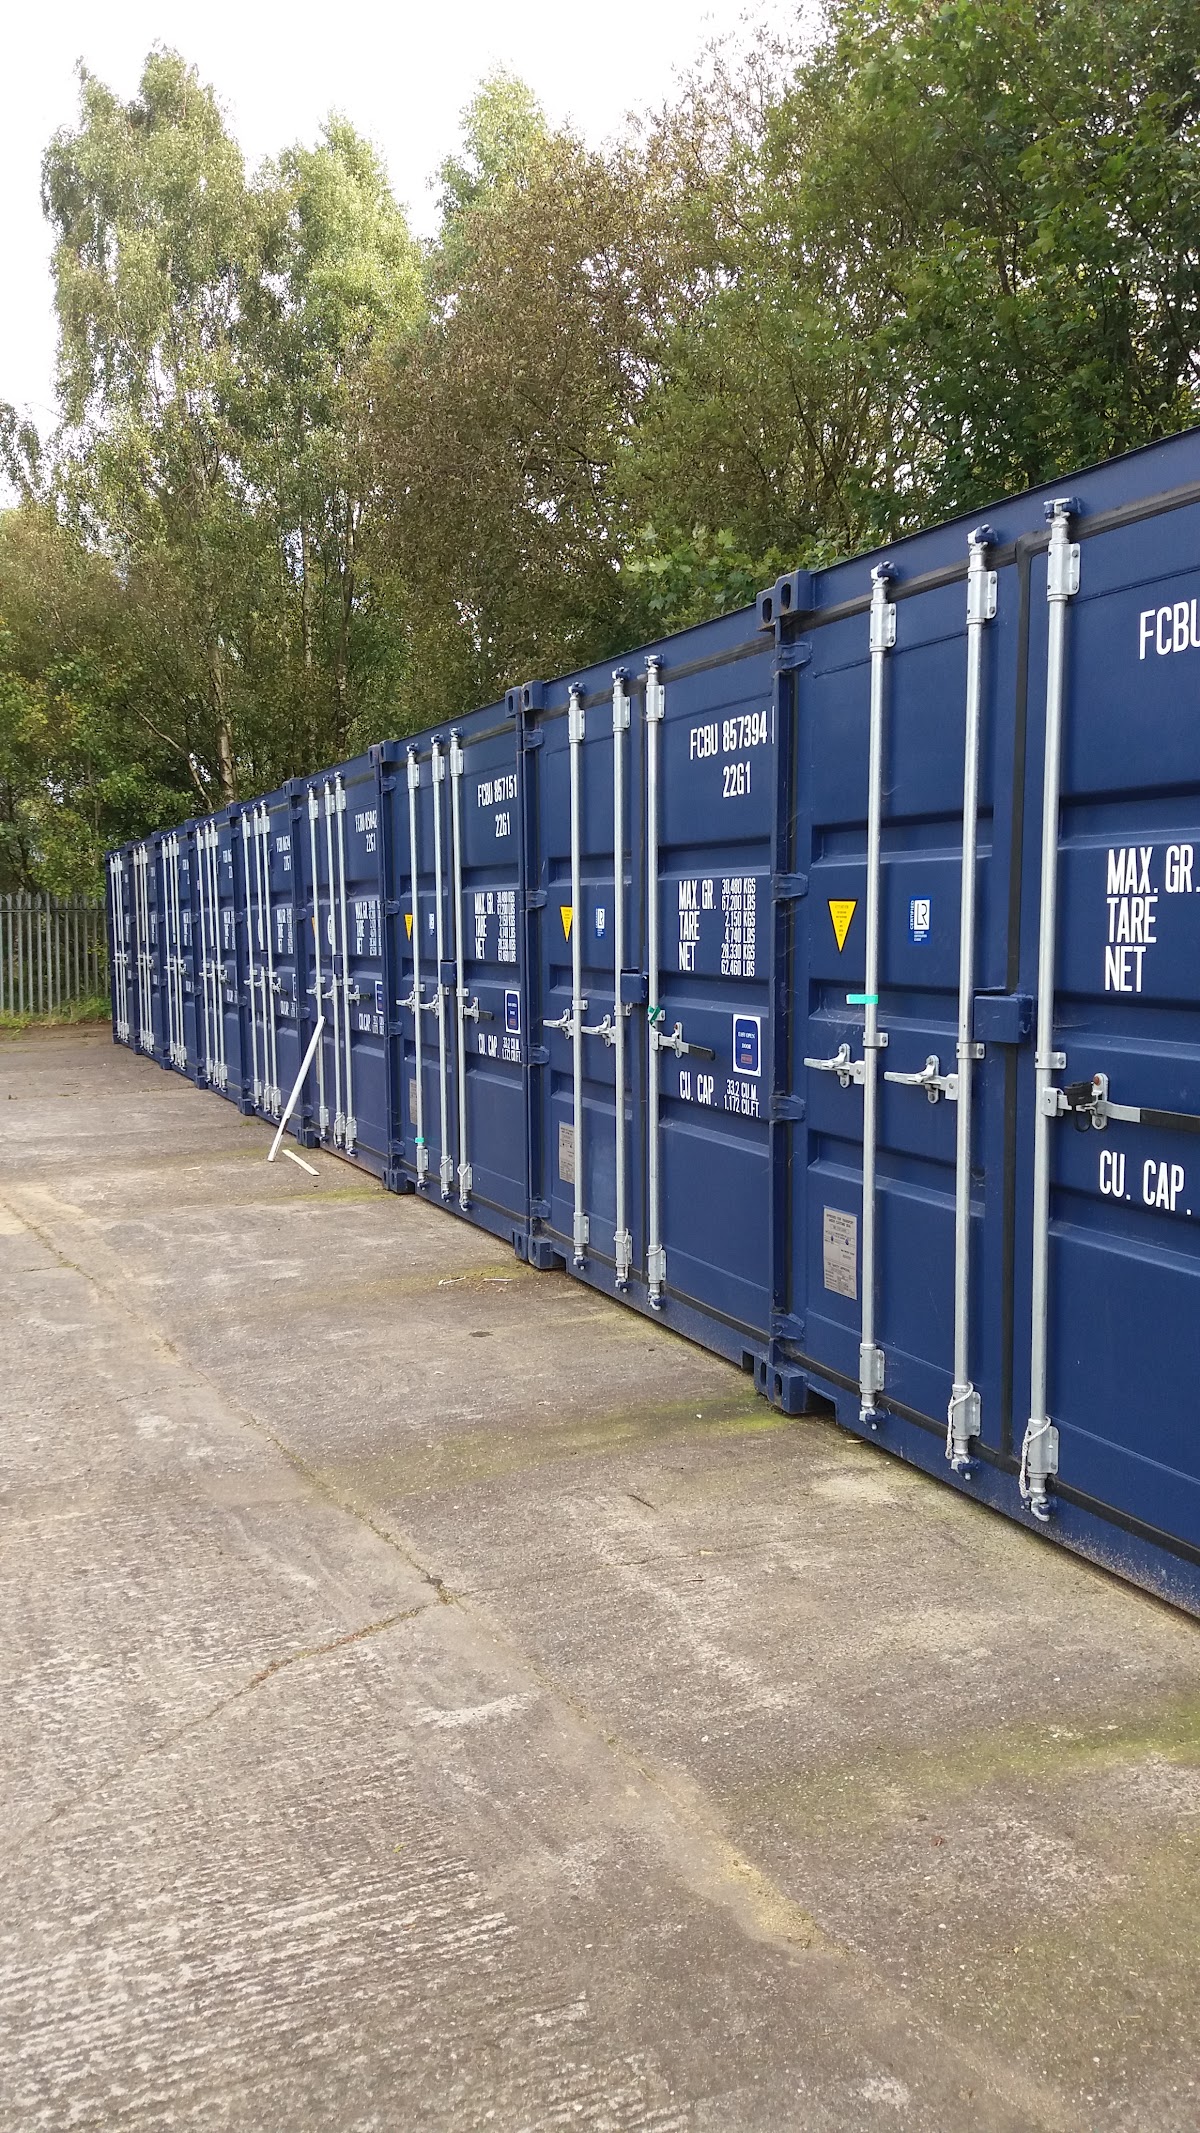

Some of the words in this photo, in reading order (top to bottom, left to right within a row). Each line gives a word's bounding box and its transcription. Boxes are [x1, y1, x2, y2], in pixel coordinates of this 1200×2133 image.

[690, 722, 719, 760] FCBU
[722, 710, 767, 752] 857394
[477, 782, 494, 808] FCBU
[494, 774, 518, 803] 857151
[723, 760, 751, 798] 22G1
[495, 811, 511, 838] 22G1
[1106, 846, 1158, 895] MAX.
[1165, 844, 1200, 893] GR.
[678, 880, 700, 910] MAX.
[701, 879, 716, 910] GR.
[743, 877, 756, 895] KGS
[743, 894, 756, 911] LBS
[678, 911, 700, 940] TARE
[743, 911, 756, 928] KGS
[1106, 896, 1158, 943] TARE
[743, 927, 756, 944] LBS
[678, 941, 696, 971] NET
[743, 944, 756, 960] KGS
[743, 960, 755, 977] LBS
[1104, 945, 1147, 993] NET
[679, 1070, 694, 1101] CU.
[697, 1073, 718, 1106] CAP.
[726, 1079, 740, 1097] 33.2
[741, 1082, 758, 1101] CU.M.
[741, 1098, 761, 1118] CU.FT.
[1099, 1149, 1131, 1200] CU.
[1142, 1159, 1192, 1215] CAP.
